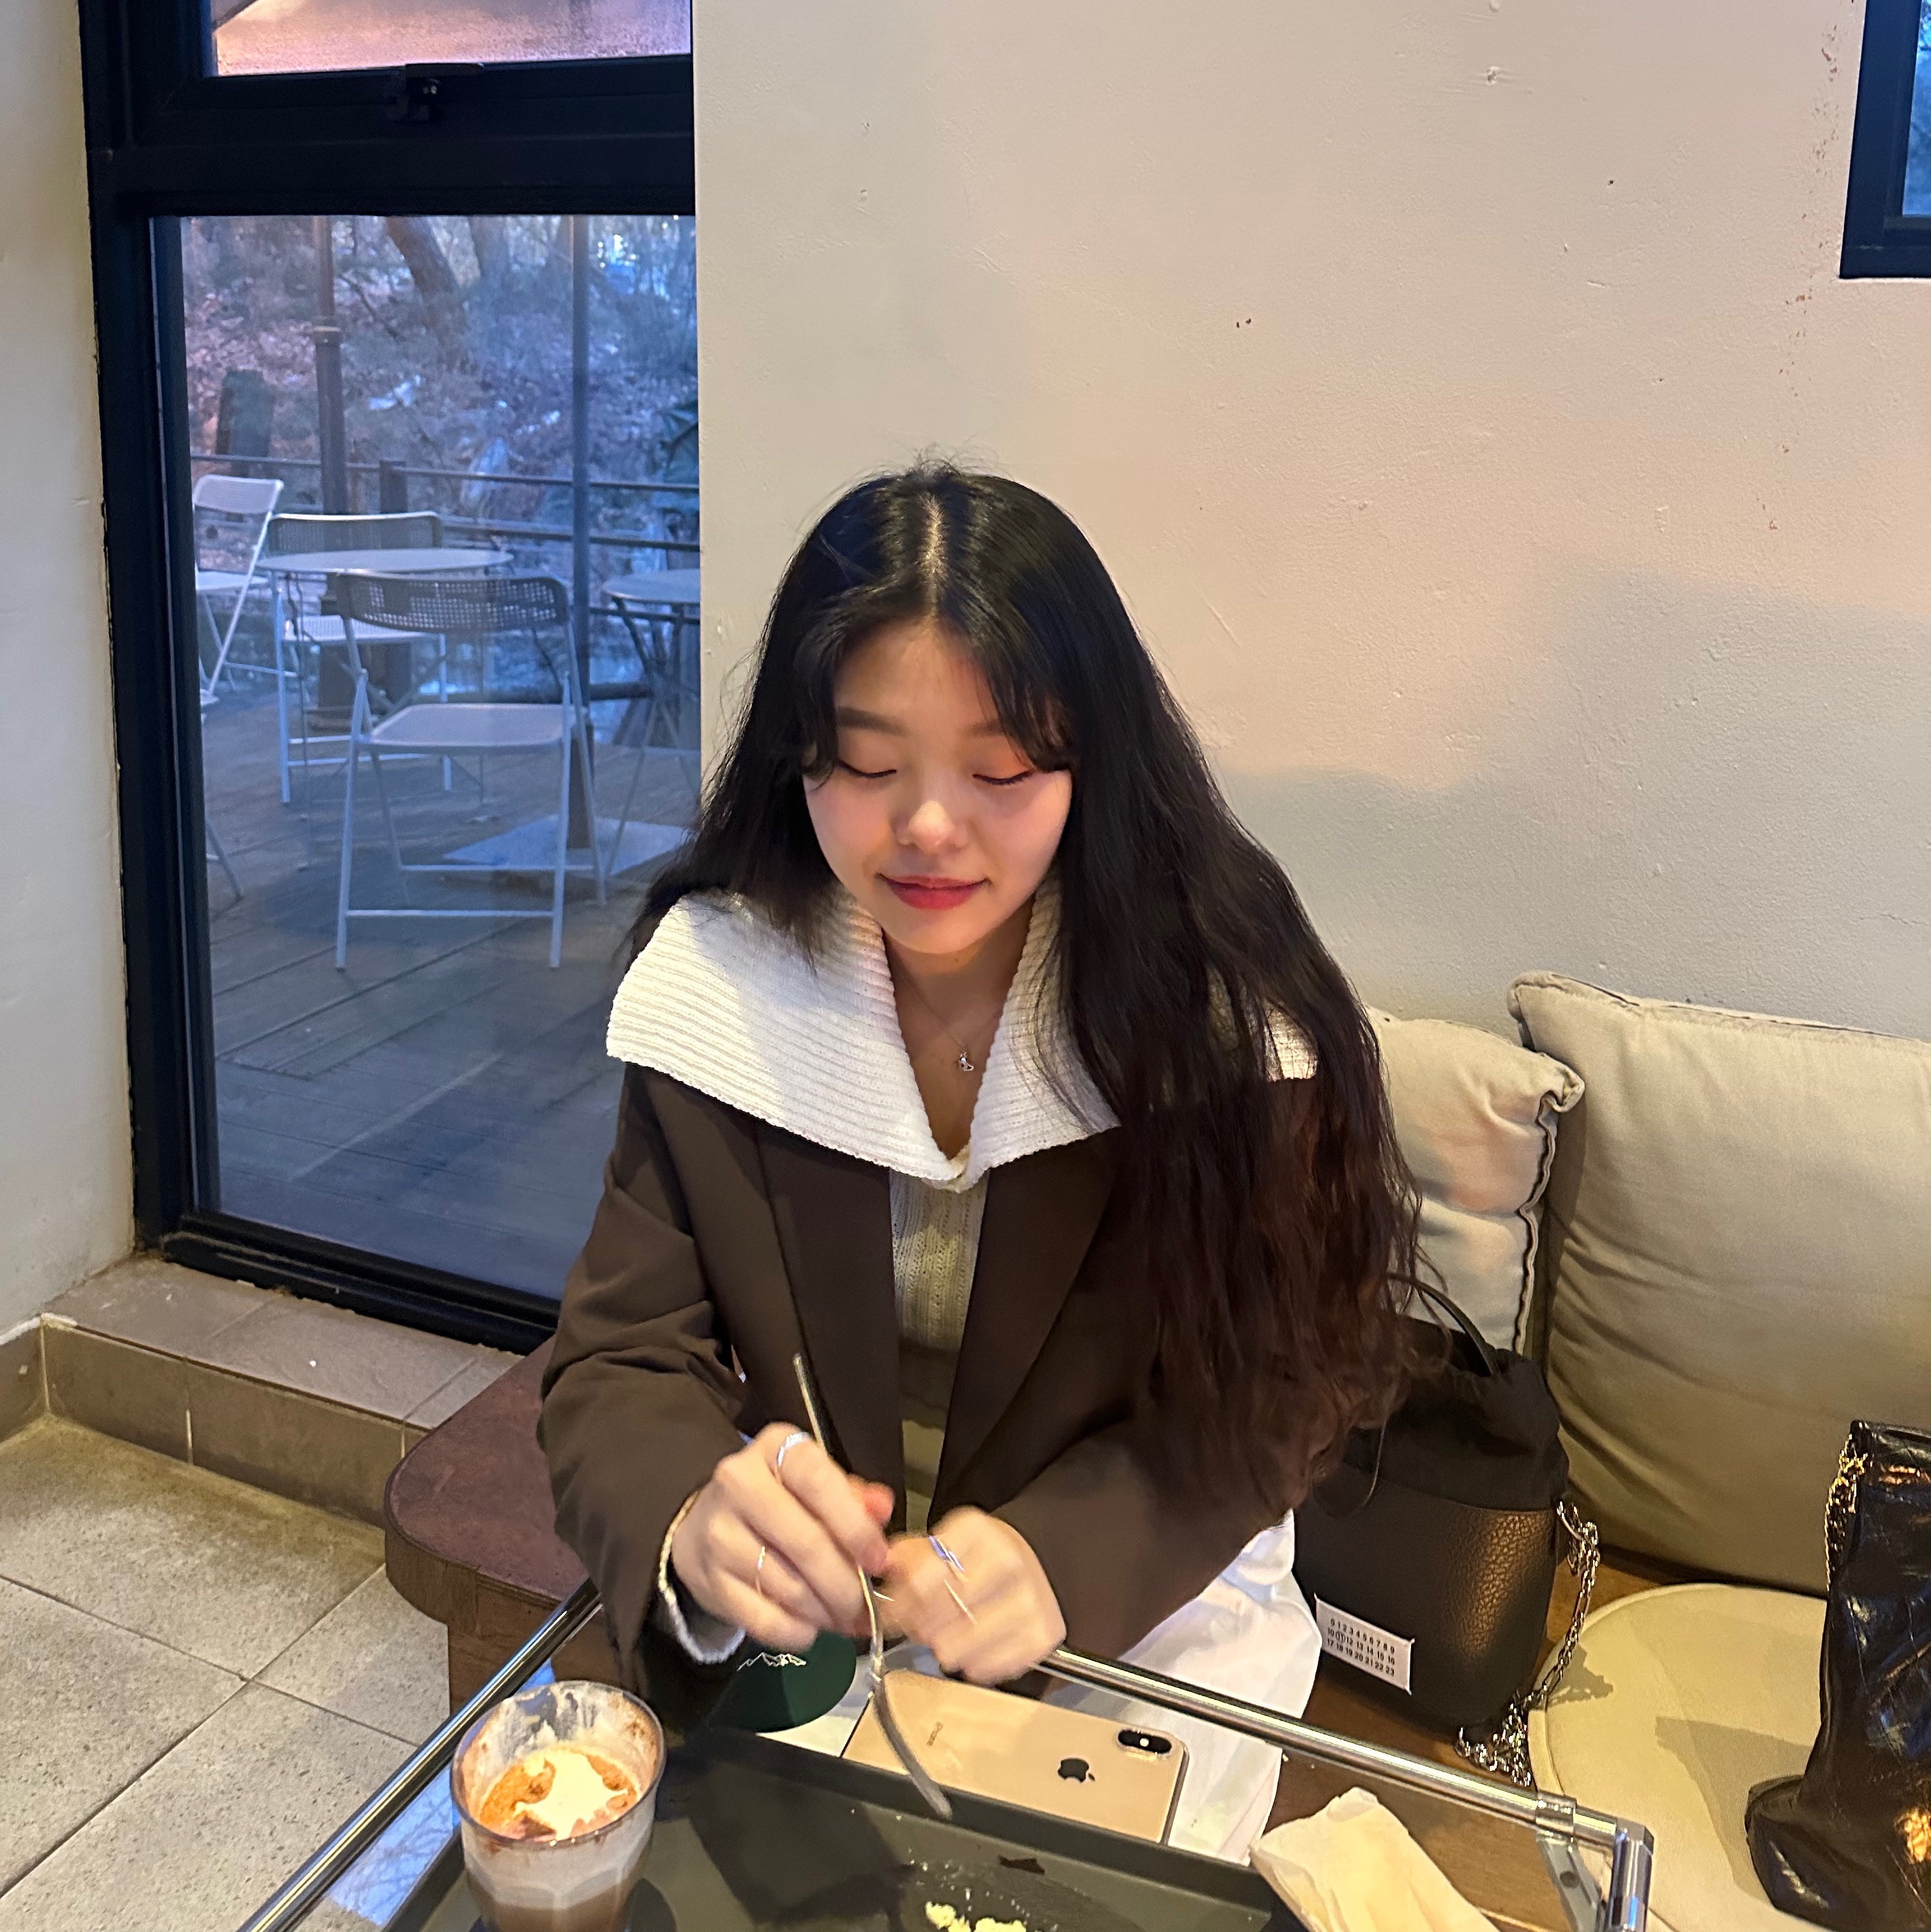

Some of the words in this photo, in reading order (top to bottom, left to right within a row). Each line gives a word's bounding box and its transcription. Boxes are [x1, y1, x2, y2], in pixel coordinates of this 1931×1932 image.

[1331, 1618, 1335, 1627] 0
[1343, 1623, 1347, 1632] 2
[1349, 1627, 1354, 1636] 3
[1356, 1630, 1360, 1639] 4
[1376, 1639, 1380, 1648] 7
[1347, 1636, 1354, 1647] 12
[1357, 1641, 1364, 1652] 13
[1367, 1646, 1373, 1656] 14
[1327, 1639, 1334, 1647] 17
[1346, 1648, 1353, 1657] 19
[1354, 1652, 1364, 1662] 20
[1365, 1656, 1373, 1667] 21
[1375, 1662, 1384, 1672] 22
[1385, 1666, 1394, 1677] 23
